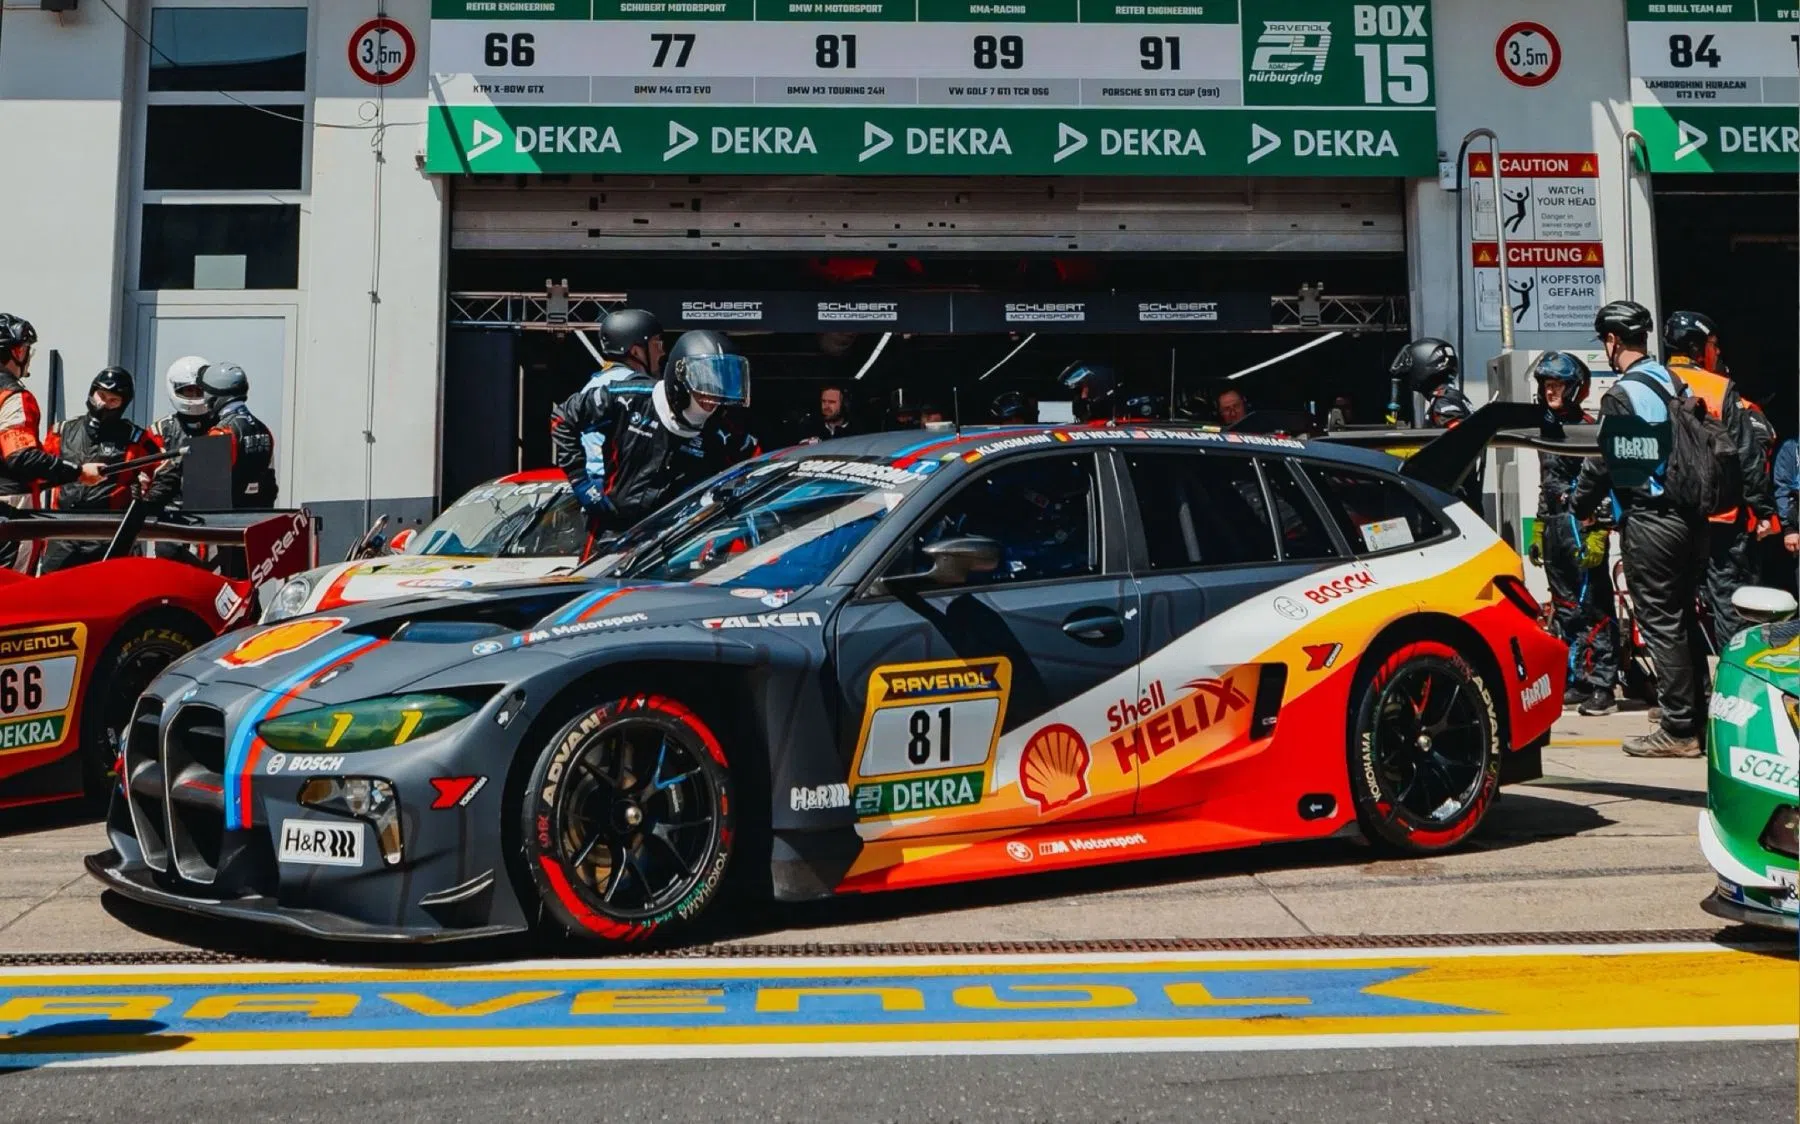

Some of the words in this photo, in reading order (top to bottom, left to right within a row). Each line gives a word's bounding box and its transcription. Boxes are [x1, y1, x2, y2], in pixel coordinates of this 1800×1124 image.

[466, 2, 497, 11] REITER
[498, 3, 555, 12] ENGINEERING
[620, 3, 666, 13] SCHUBERT
[668, 3, 726, 13] MOTORSPORT
[789, 4, 811, 14] BMW
[812, 4, 823, 14] M
[825, 4, 883, 14] MOTORSPORT
[970, 5, 1026, 14] KMA-RACING
[1115, 6, 1145, 15] REITER
[1147, 6, 1203, 16] ENGINEERING
[1648, 4, 1665, 14] RED
[1667, 4, 1689, 14] BULL
[1690, 4, 1714, 14] TEAM
[1715, 4, 1733, 14] ABT
[1269, 24, 1325, 32] RAVENOL
[1354, 5, 1427, 37] BOX
[485, 33, 535, 67] 66
[651, 33, 696, 68] 77
[816, 34, 856, 69] 81
[974, 35, 1024, 69] 89
[1140, 36, 1181, 70] 91
[1669, 34, 1721, 69] 84
[1248, 71, 1323, 85] nürburgring
[1355, 44, 1429, 104] 15
[473, 84, 492, 94] KTM
[528, 85, 544, 94] GTX
[634, 85, 657, 95] BMW
[659, 85, 673, 95] M4
[676, 85, 692, 95] GT3
[694, 85, 711, 95] EVO
[787, 86, 810, 96] BMW
[812, 86, 825, 96] M3
[828, 86, 865, 96] TOURING
[867, 86, 885, 96] 24H
[949, 87, 963, 96] VW
[966, 87, 988, 96] GOLF
[990, 87, 996, 96] 7
[998, 87, 1011, 96] GTI
[1014, 87, 1031, 96] TCR
[1033, 87, 1049, 96] DSG
[1102, 88, 1141, 97] PORSCHE
[1144, 88, 1158, 97] 911
[1160, 88, 1176, 97] GT3
[1178, 88, 1195, 97] CUP
[1197, 88, 1220, 98] (991)
[1645, 80, 1703, 90] LAMBORGHINI
[1705, 81, 1746, 89] HURACAN
[1676, 91, 1692, 99] GT3
[515, 126, 622, 154] DEKRA
[711, 127, 817, 154] DEKRA
[906, 128, 1012, 155] DEKRA
[1101, 129, 1206, 156] DEKRA
[1294, 130, 1399, 157] DEKRA
[1500, 159, 1569, 172] CAUTION
[1548, 186, 1584, 195] WATCH
[1537, 197, 1565, 206] YOUR
[1568, 197, 1596, 206] HEAD
[1496, 248, 1582, 262] CHTUNG
[1548, 288, 1595, 297] GEFAHR
[682, 302, 762, 310] SCHUBERT
[817, 303, 897, 311] SCHUBERT
[1005, 303, 1085, 311] SCHUBERT
[1138, 302, 1217, 311] SCHUBERT
[1070, 431, 1085, 440] DE
[1085, 430, 1130, 440] WILDE
[1148, 430, 1162, 440] DE
[976, 434, 1051, 456] KLINGMANN
[1304, 570, 1377, 604] BOSCH
[552, 612, 648, 637] Motorsport
[702, 612, 822, 629] FALKEN
[0, 635, 70, 654] AVENOL
[0, 665, 42, 714] 66
[891, 671, 991, 694] RAVENOL
[1107, 680, 1166, 733] Shell
[1472, 676, 1500, 754] ADVAN
[0, 719, 56, 748] EKRA
[1110, 677, 1250, 775] HELIX
[908, 707, 951, 765] 81
[288, 756, 346, 771] BOSCH
[543, 713, 601, 807] ADVAN
[1362, 732, 1382, 803] YOKOHAMA
[893, 776, 975, 811] DEKRA
[1071, 832, 1147, 852] Motorsport
[679, 852, 728, 919] YOKOHAMA
[0, 981, 1313, 1022] RAVENOL
